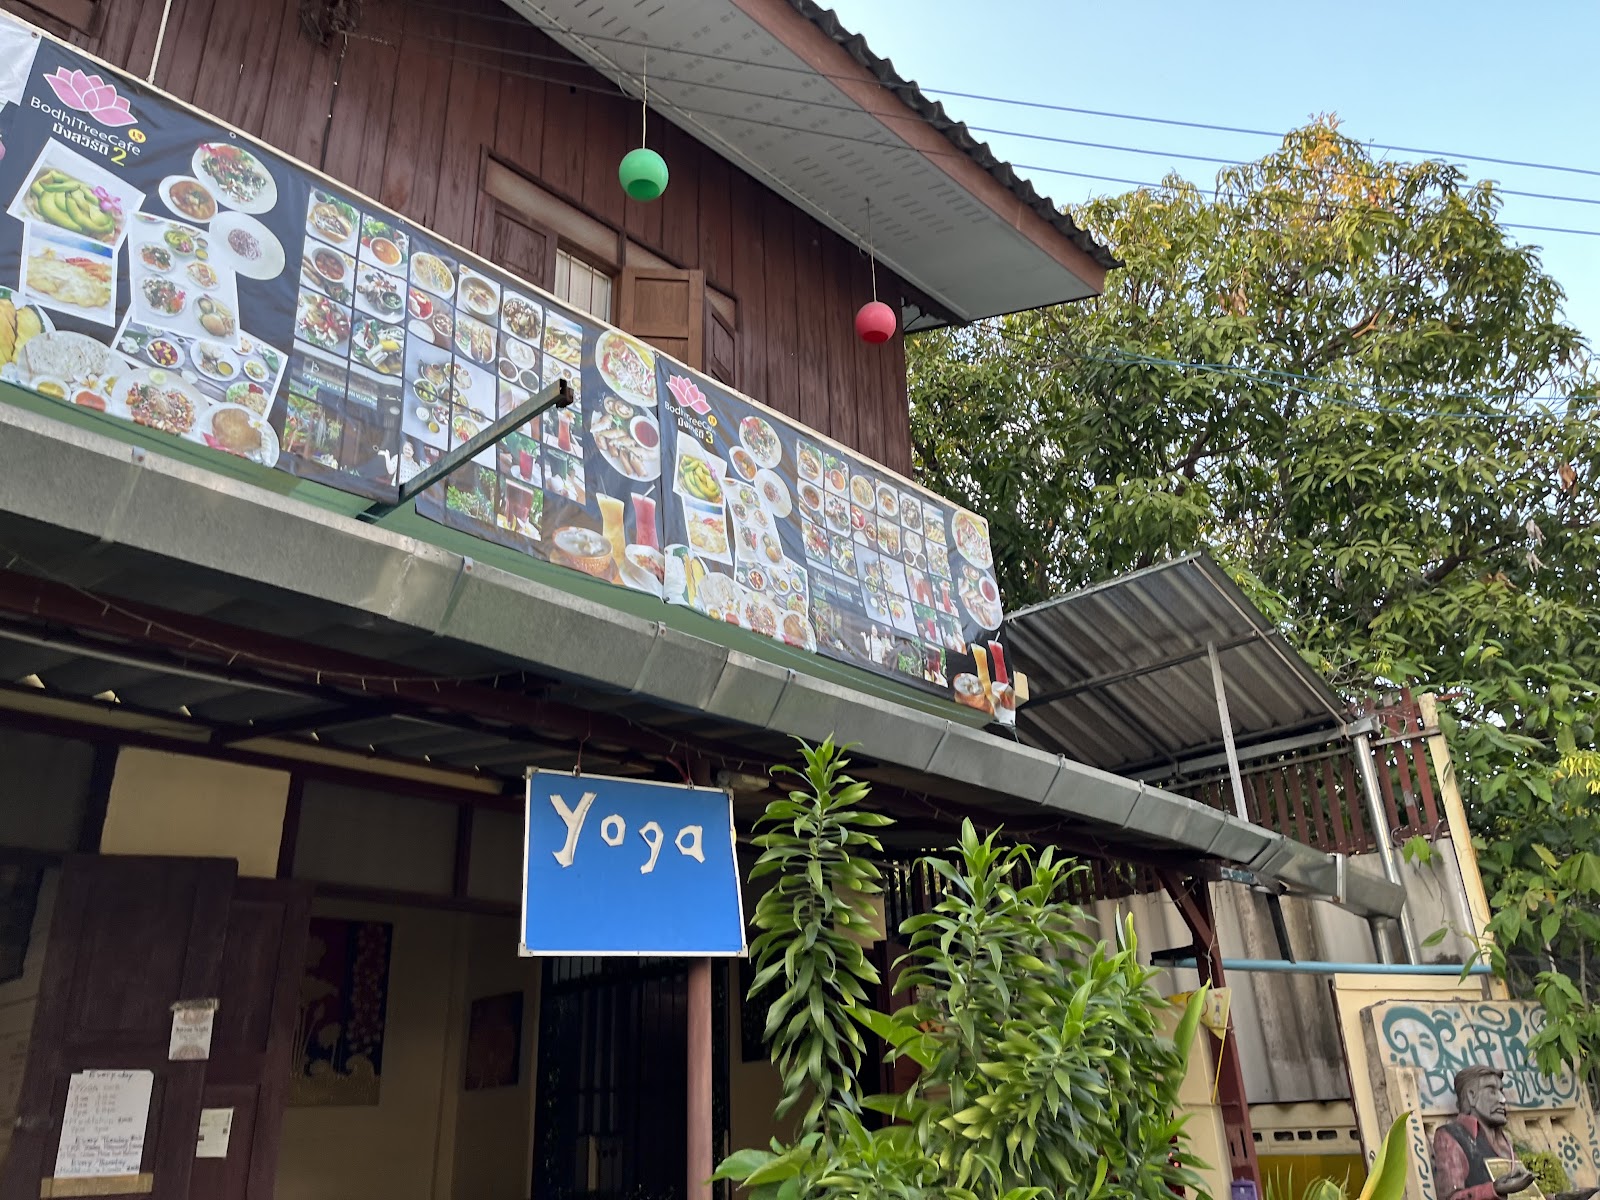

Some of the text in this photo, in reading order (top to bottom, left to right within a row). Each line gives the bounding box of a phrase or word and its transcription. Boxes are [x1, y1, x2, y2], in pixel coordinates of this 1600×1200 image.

[30, 96, 141, 156] BodhiTreeCafe
[110, 147, 127, 167] 2
[705, 430, 714, 445] 3
[550, 791, 706, 875] Yoga
